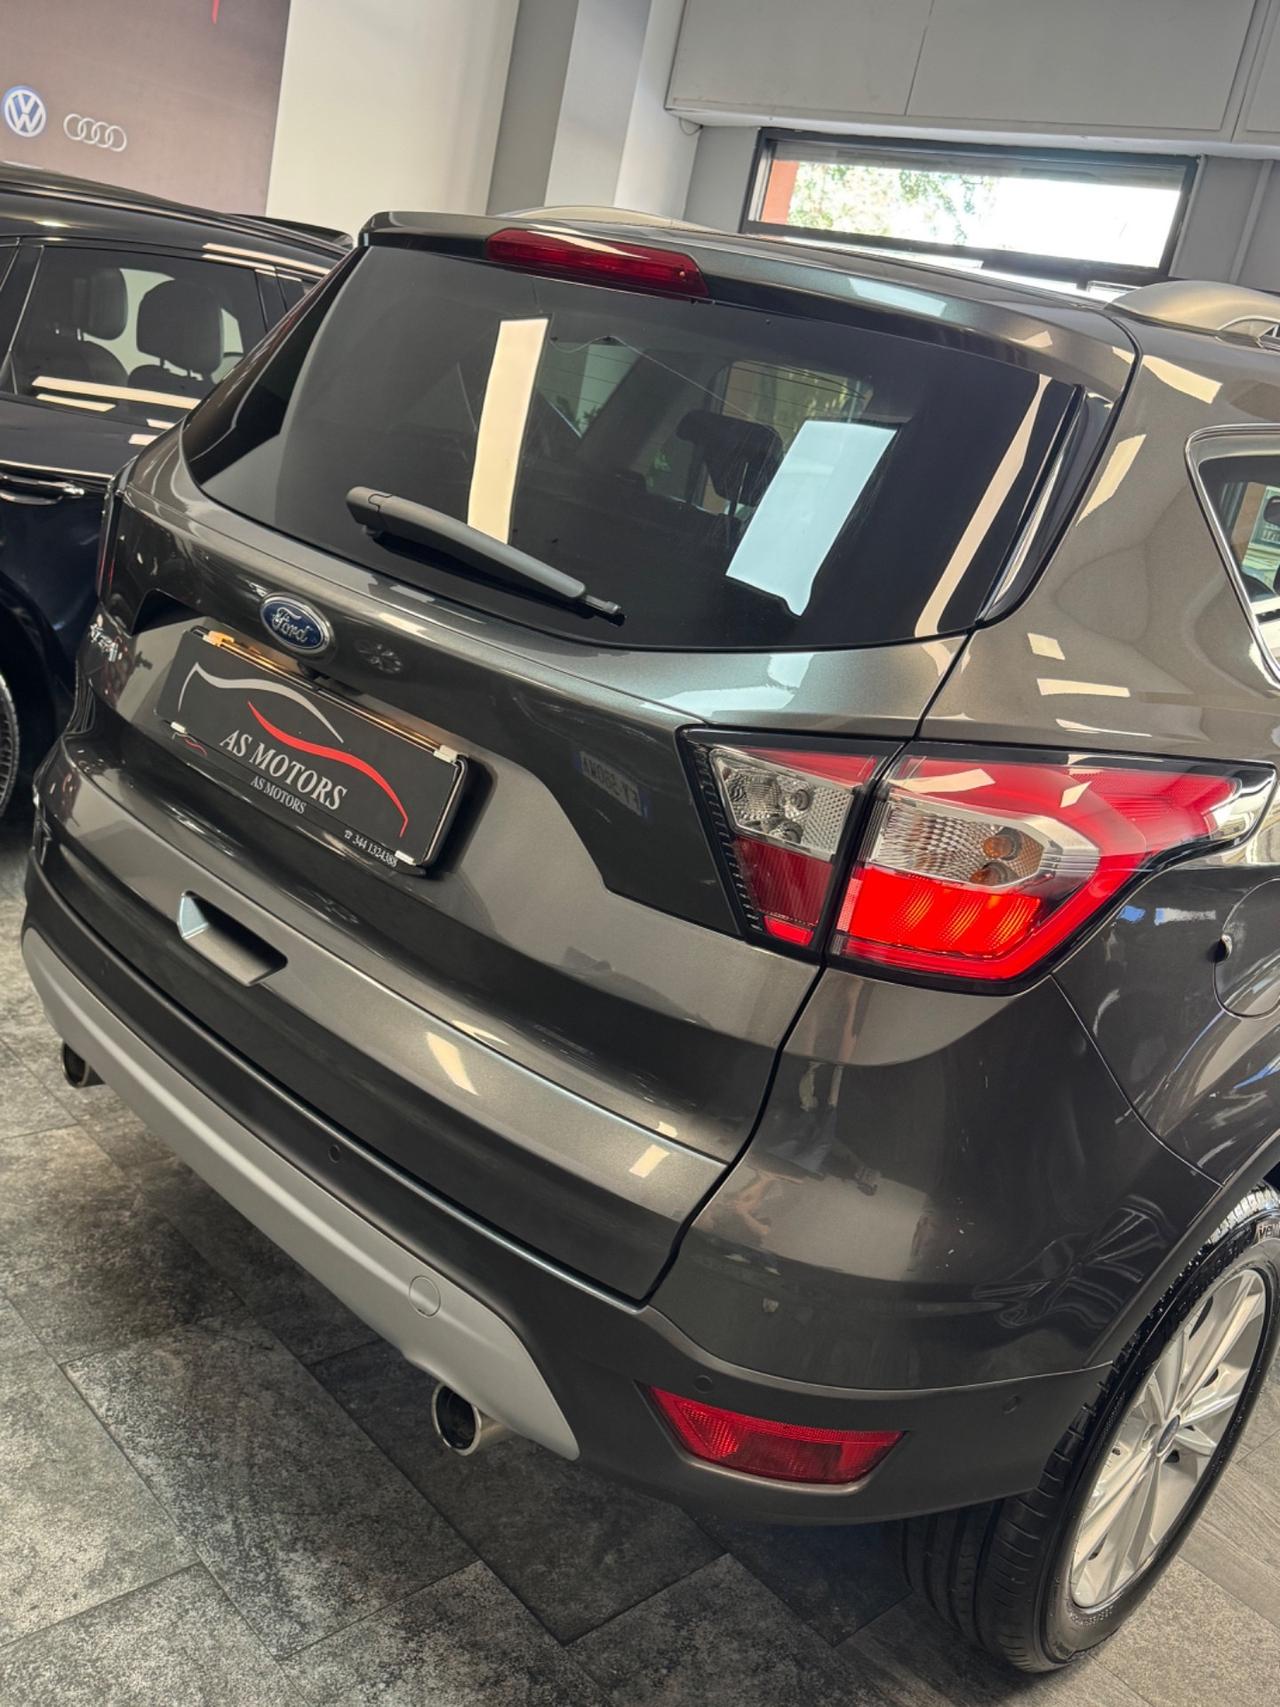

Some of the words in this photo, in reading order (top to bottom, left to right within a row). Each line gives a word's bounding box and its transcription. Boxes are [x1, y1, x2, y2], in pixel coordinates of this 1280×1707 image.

[271, 606, 312, 643] Ford
[220, 729, 253, 757] AS
[249, 742, 348, 810] MOTORS
[250, 775, 265, 791] AS
[263, 783, 307, 814] MOTORS
